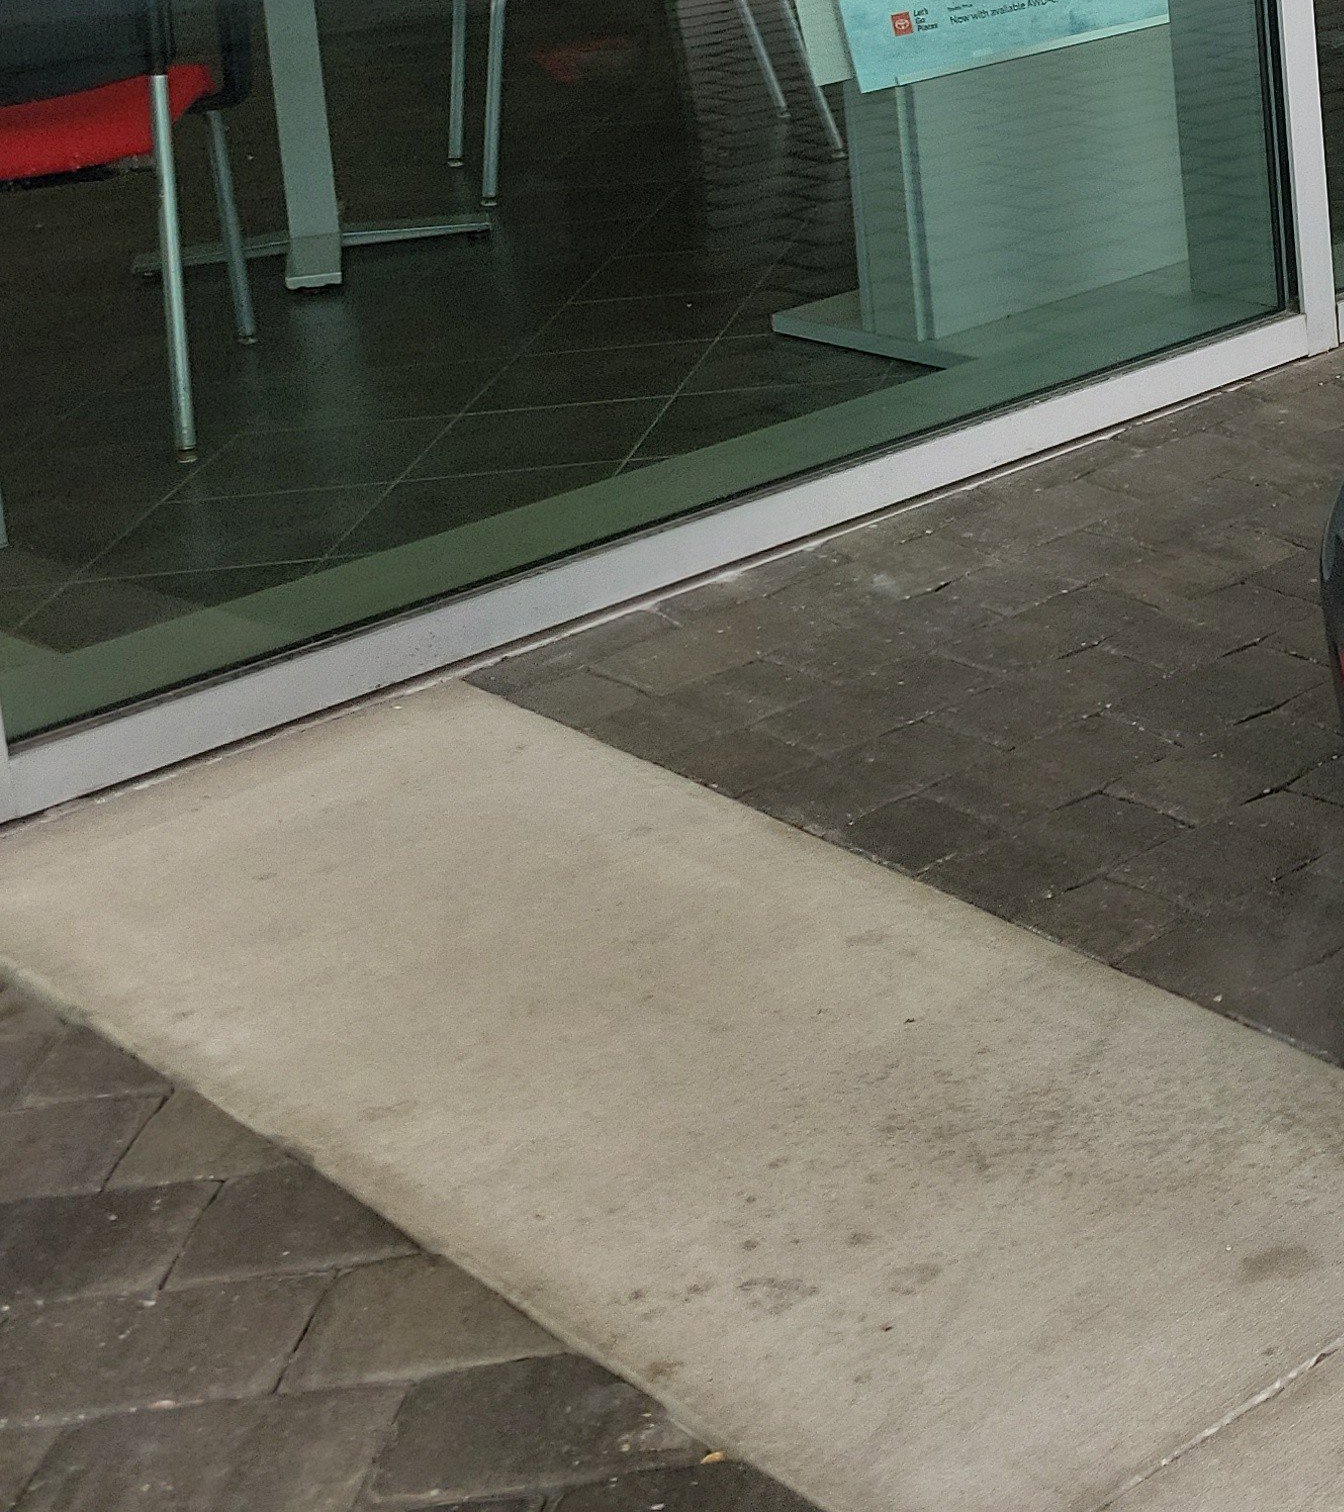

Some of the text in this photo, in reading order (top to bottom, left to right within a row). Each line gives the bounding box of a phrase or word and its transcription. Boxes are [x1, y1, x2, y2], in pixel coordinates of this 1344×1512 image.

[949, 14, 969, 24] Now
[970, 9, 989, 20] with
[990, 2, 1026, 16] available
